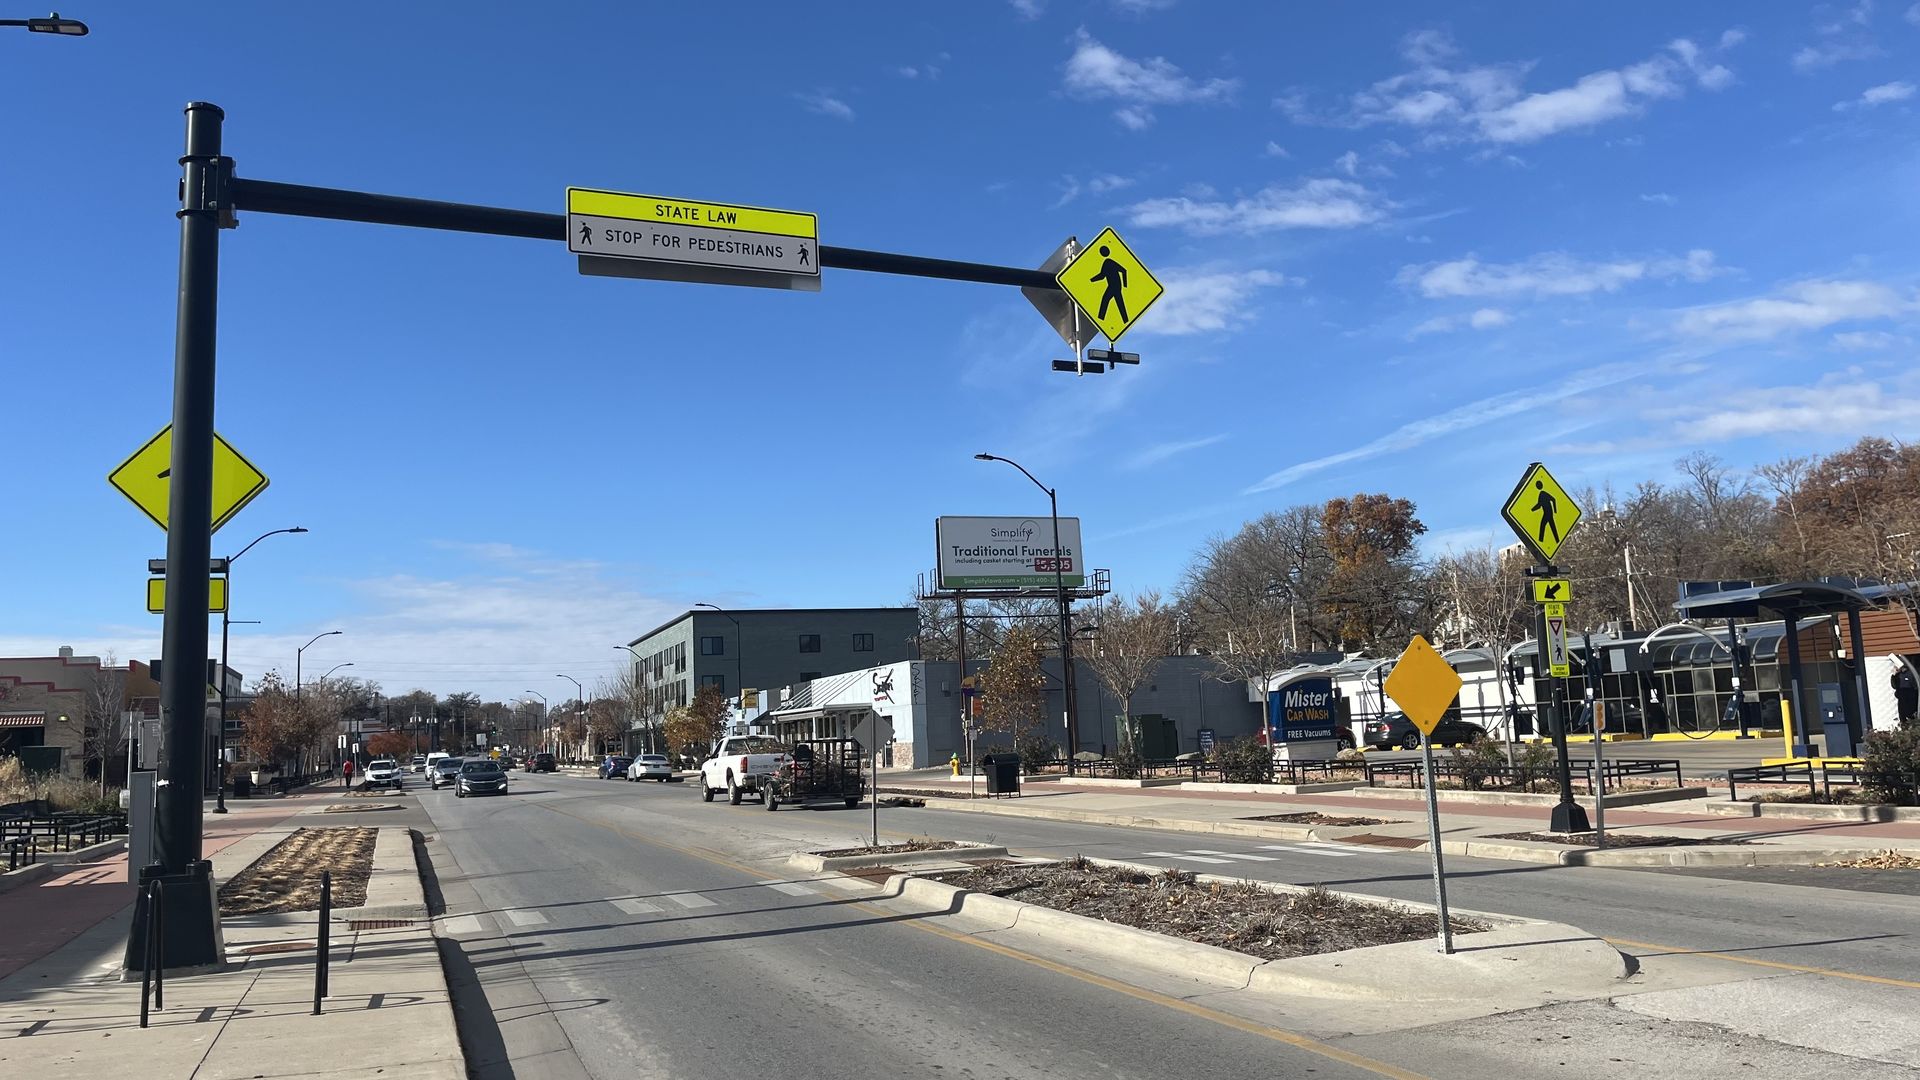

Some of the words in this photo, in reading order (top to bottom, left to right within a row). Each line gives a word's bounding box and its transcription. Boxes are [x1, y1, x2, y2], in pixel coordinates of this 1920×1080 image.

[655, 204, 700, 221] STATE
[707, 210, 737, 225] LAW
[605, 229, 643, 244] STOP
[652, 234, 681, 248] FOR
[688, 238, 784, 258] PEDESTRIANS
[990, 528, 1033, 541] Simplify
[952, 545, 1018, 557] Traditional
[1284, 689, 1328, 708] Mister
[1287, 730, 1303, 738] FREE
[1304, 730, 1331, 738] Vacuums
